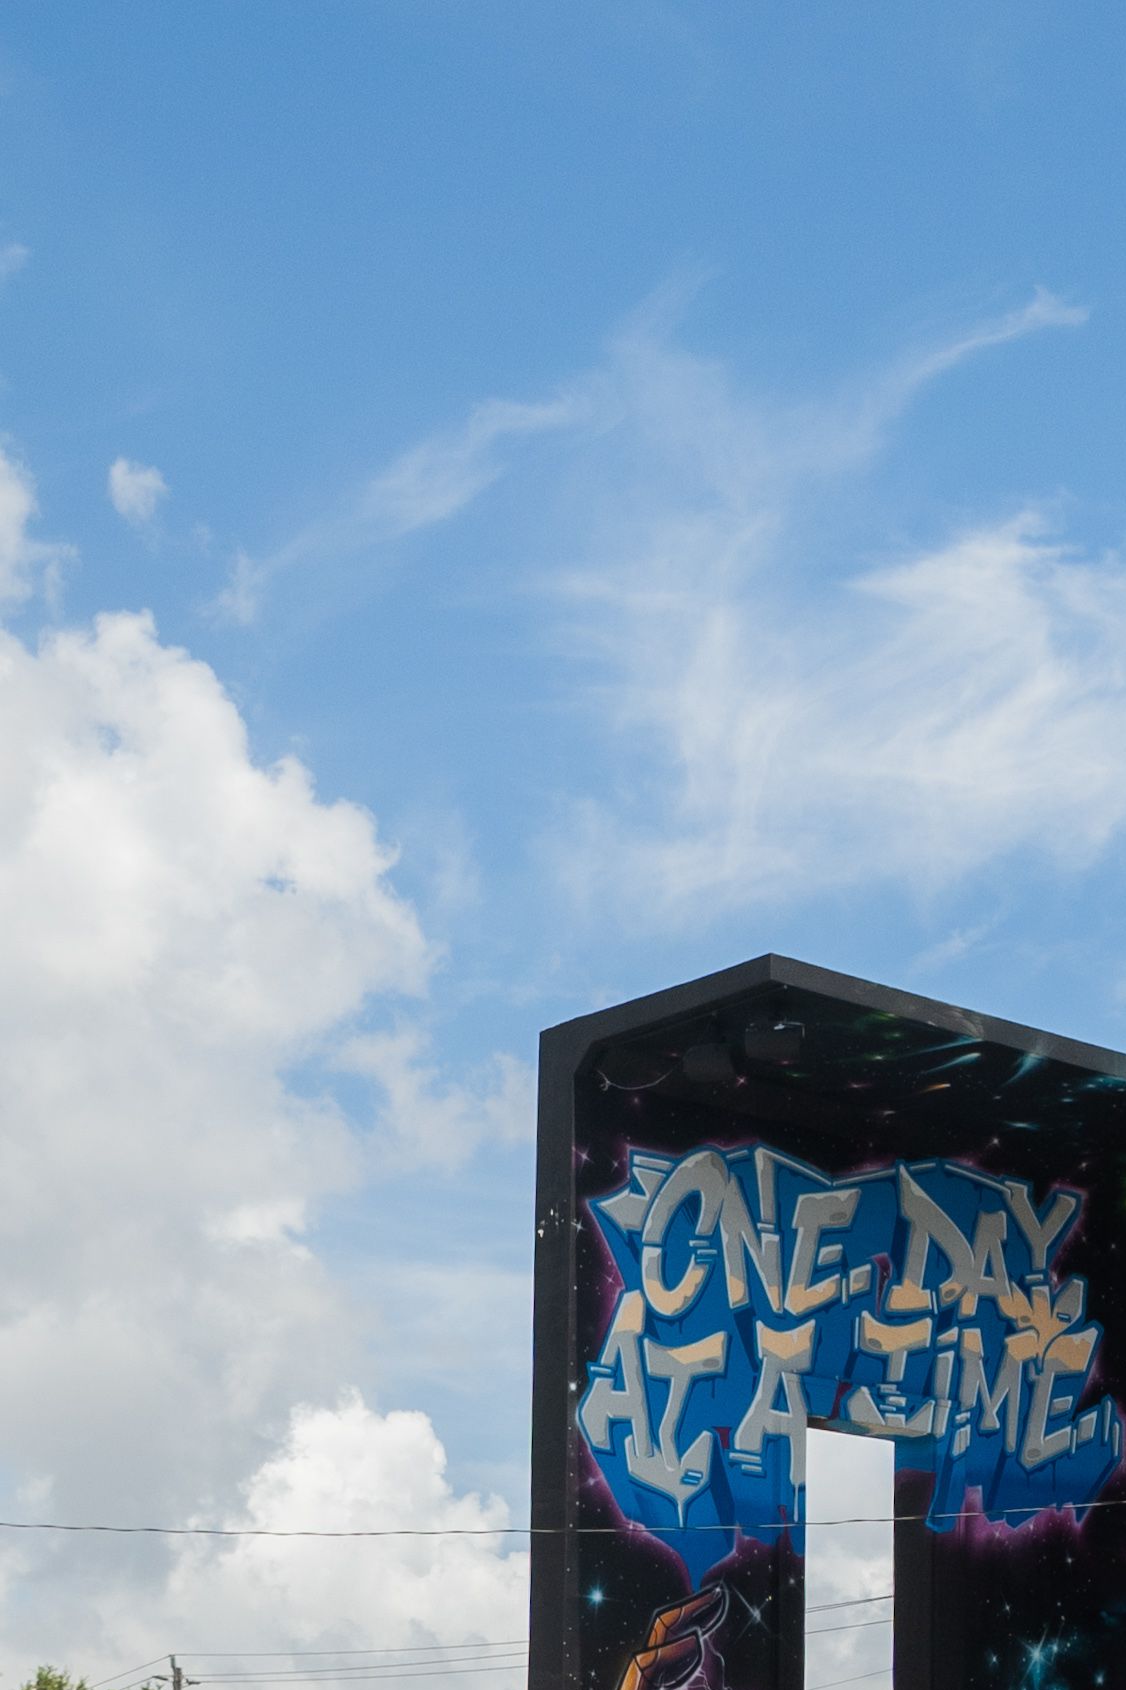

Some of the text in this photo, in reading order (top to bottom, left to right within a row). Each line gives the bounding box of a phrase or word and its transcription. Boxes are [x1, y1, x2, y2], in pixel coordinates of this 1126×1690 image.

[886, 1162, 1079, 1345] DAY
[579, 1290, 728, 1502] AT
[730, 1319, 816, 1486] A
